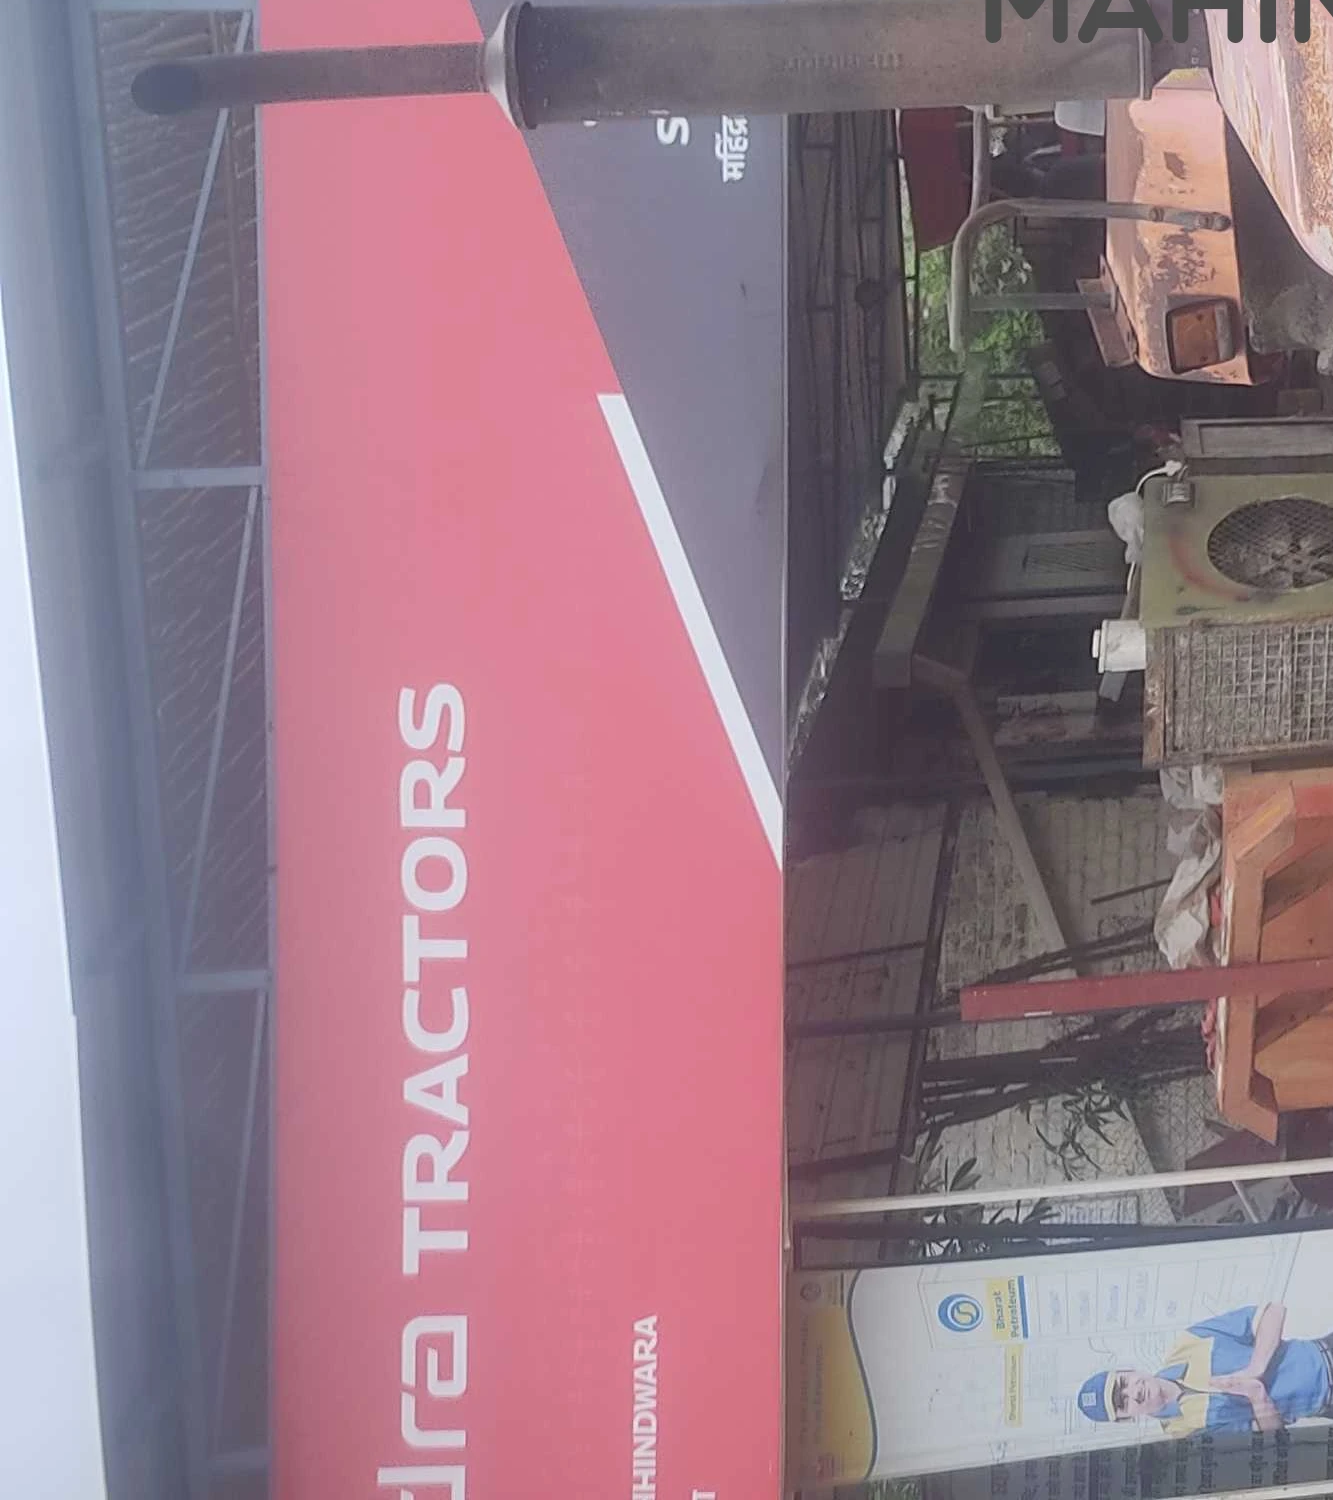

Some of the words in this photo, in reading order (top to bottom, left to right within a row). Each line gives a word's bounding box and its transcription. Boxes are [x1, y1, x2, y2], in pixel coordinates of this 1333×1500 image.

[398, 682, 470, 1275] TRACTORS
[992, 1290, 1006, 1330] Bharat
[1006, 1279, 1020, 1338] Petroleum
